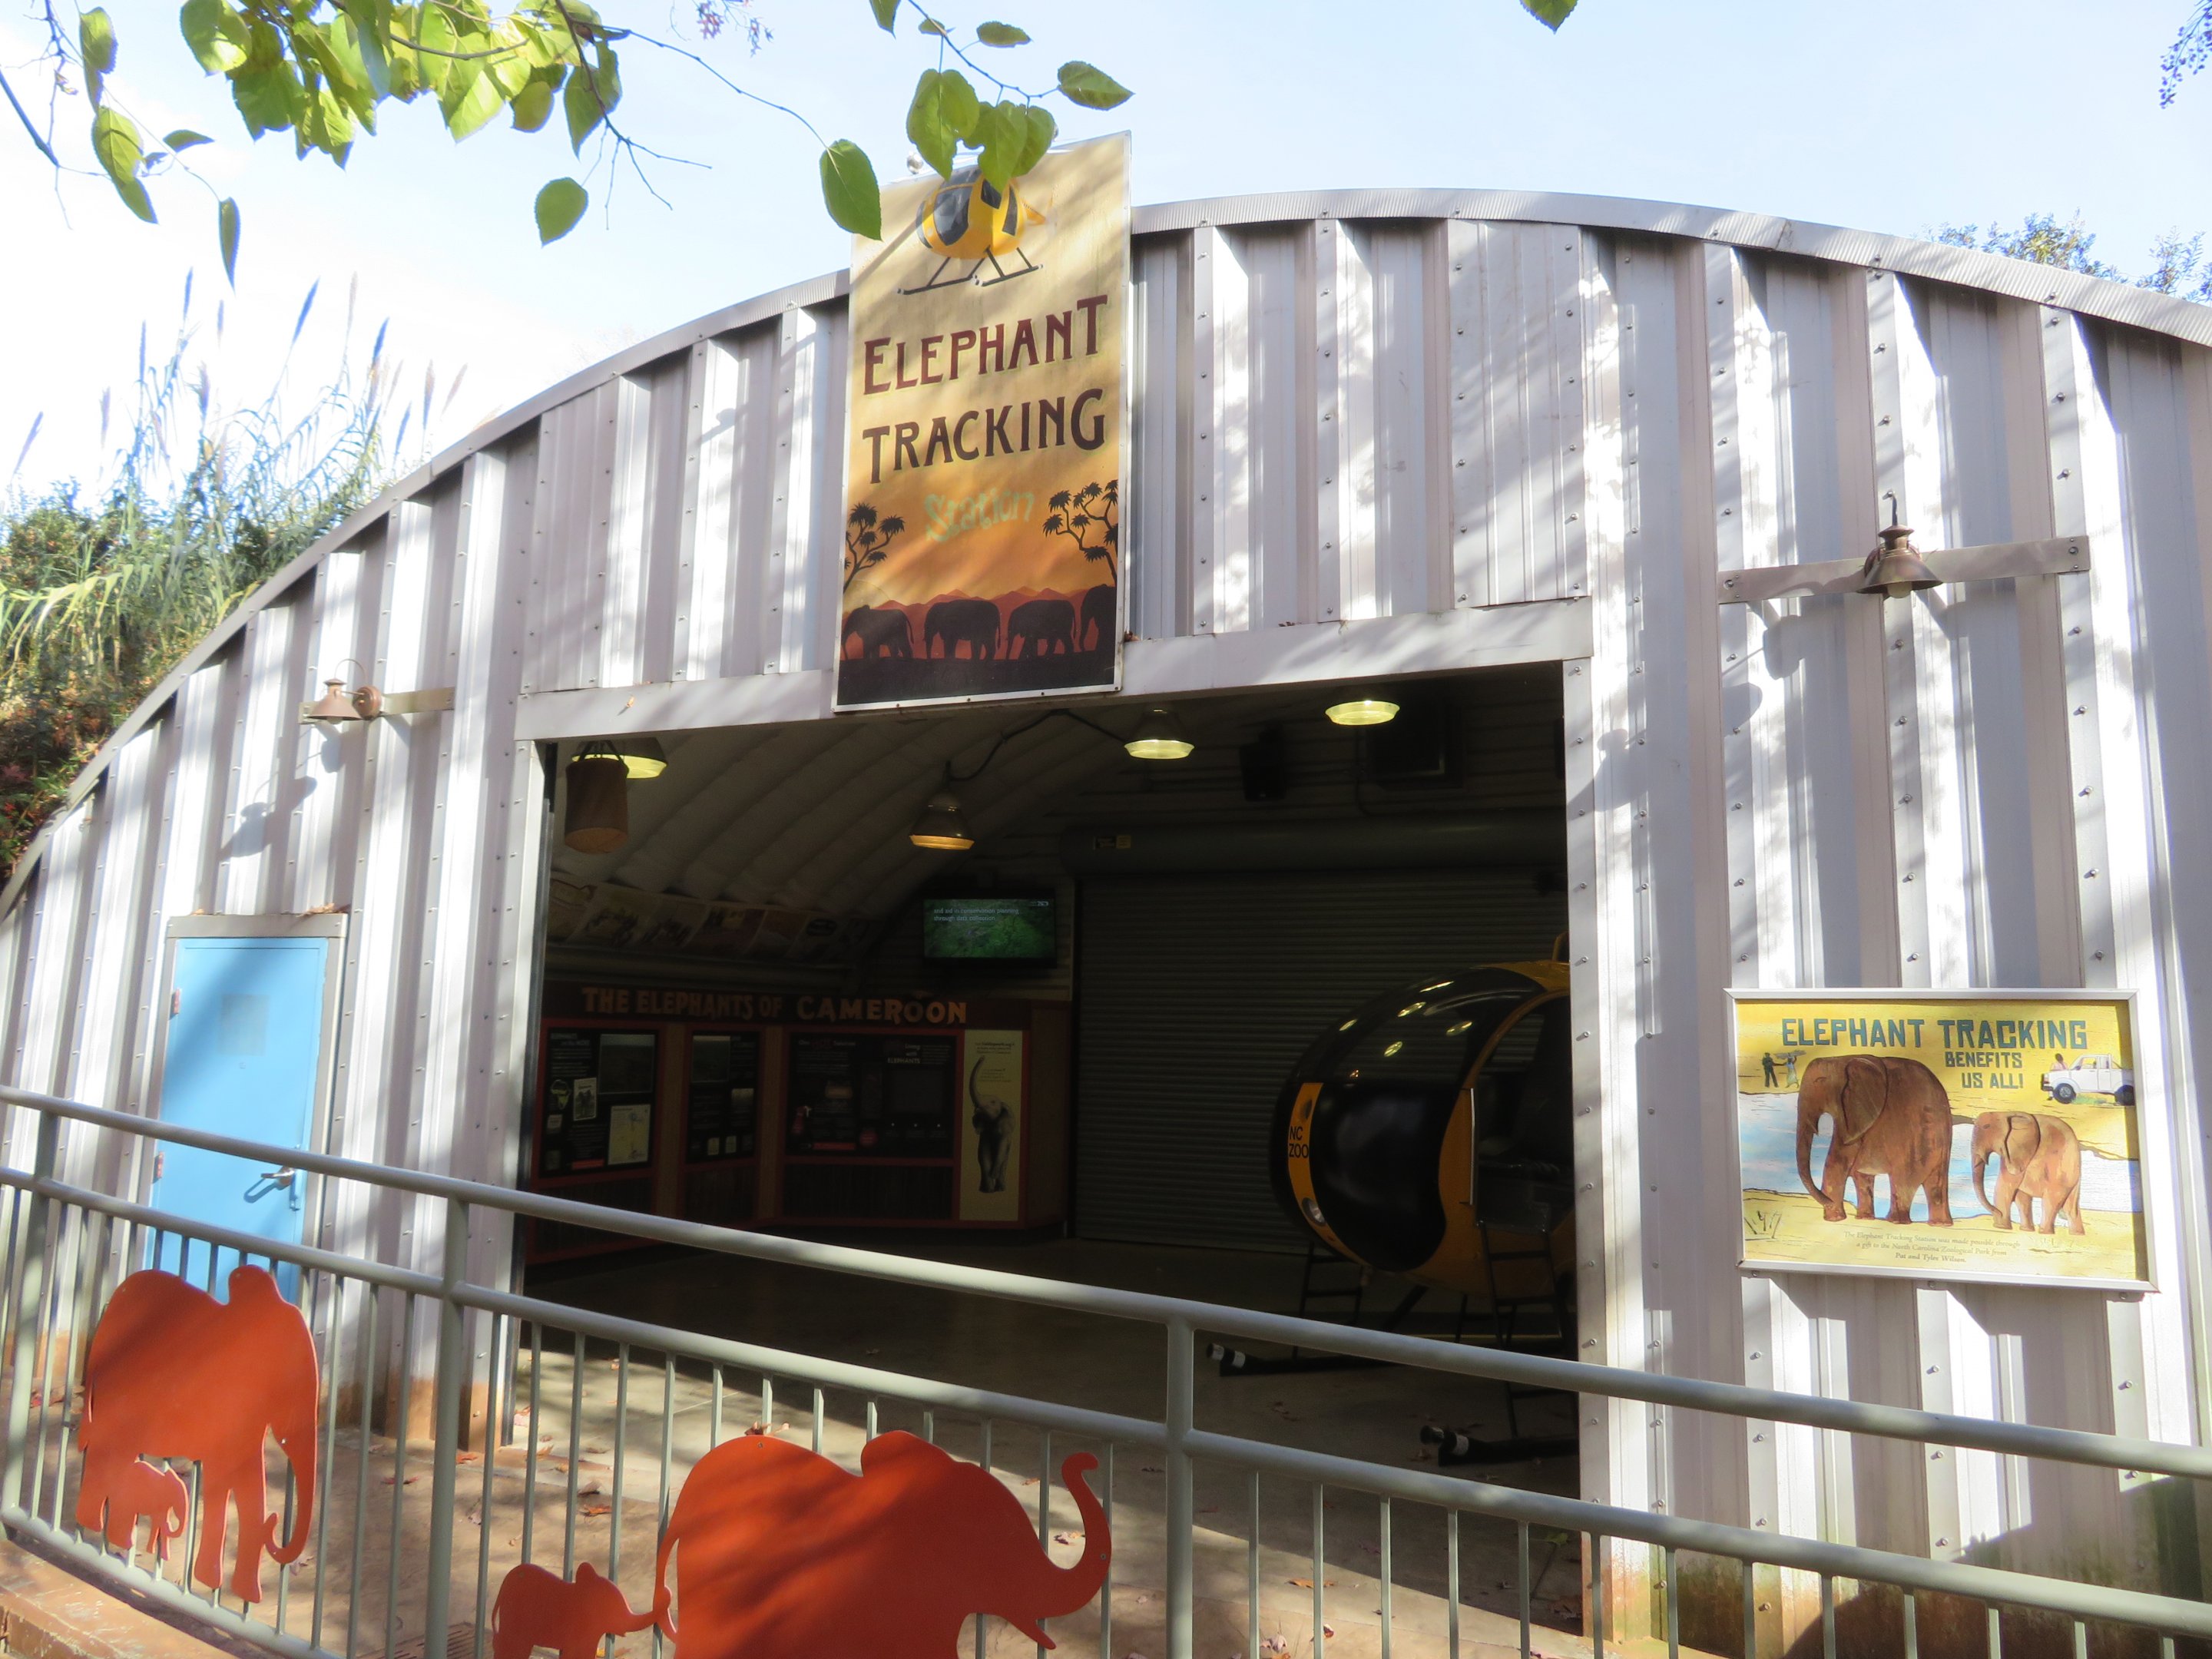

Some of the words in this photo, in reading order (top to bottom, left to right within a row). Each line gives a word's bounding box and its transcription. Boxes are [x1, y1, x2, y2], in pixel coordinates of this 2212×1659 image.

[863, 295, 1108, 395] ELEPHANT
[862, 388, 1106, 484] TRACKING
[924, 488, 1035, 542] Station
[581, 986, 631, 1014] THE
[636, 989, 753, 1020] ELEPHANTS
[759, 995, 783, 1018] OF
[796, 996, 968, 1025] CAMEROON
[1781, 1018, 1925, 1048] ELEPHANT
[1937, 1019, 2088, 1049] TRACKING
[1945, 1051, 2023, 1068] BENEFITS
[1961, 1071, 1984, 1088] US
[1989, 1072, 2025, 1089] ALL!
[1290, 1126, 1303, 1141] NC
[1289, 1144, 1309, 1158] ZOO
[1856, 1232, 1884, 1241] Elephant
[1886, 1233, 1913, 1243] Tracking
[1914, 1234, 1936, 1243] Station
[1970, 1238, 1994, 1247] possible
[1995, 1239, 2021, 1248] through
[1912, 1243, 1939, 1252] Carolina
[1940, 1245, 1973, 1255] Zoological
[1991, 1248, 2008, 1257] from
[1922, 1253, 1939, 1262] Tyler
